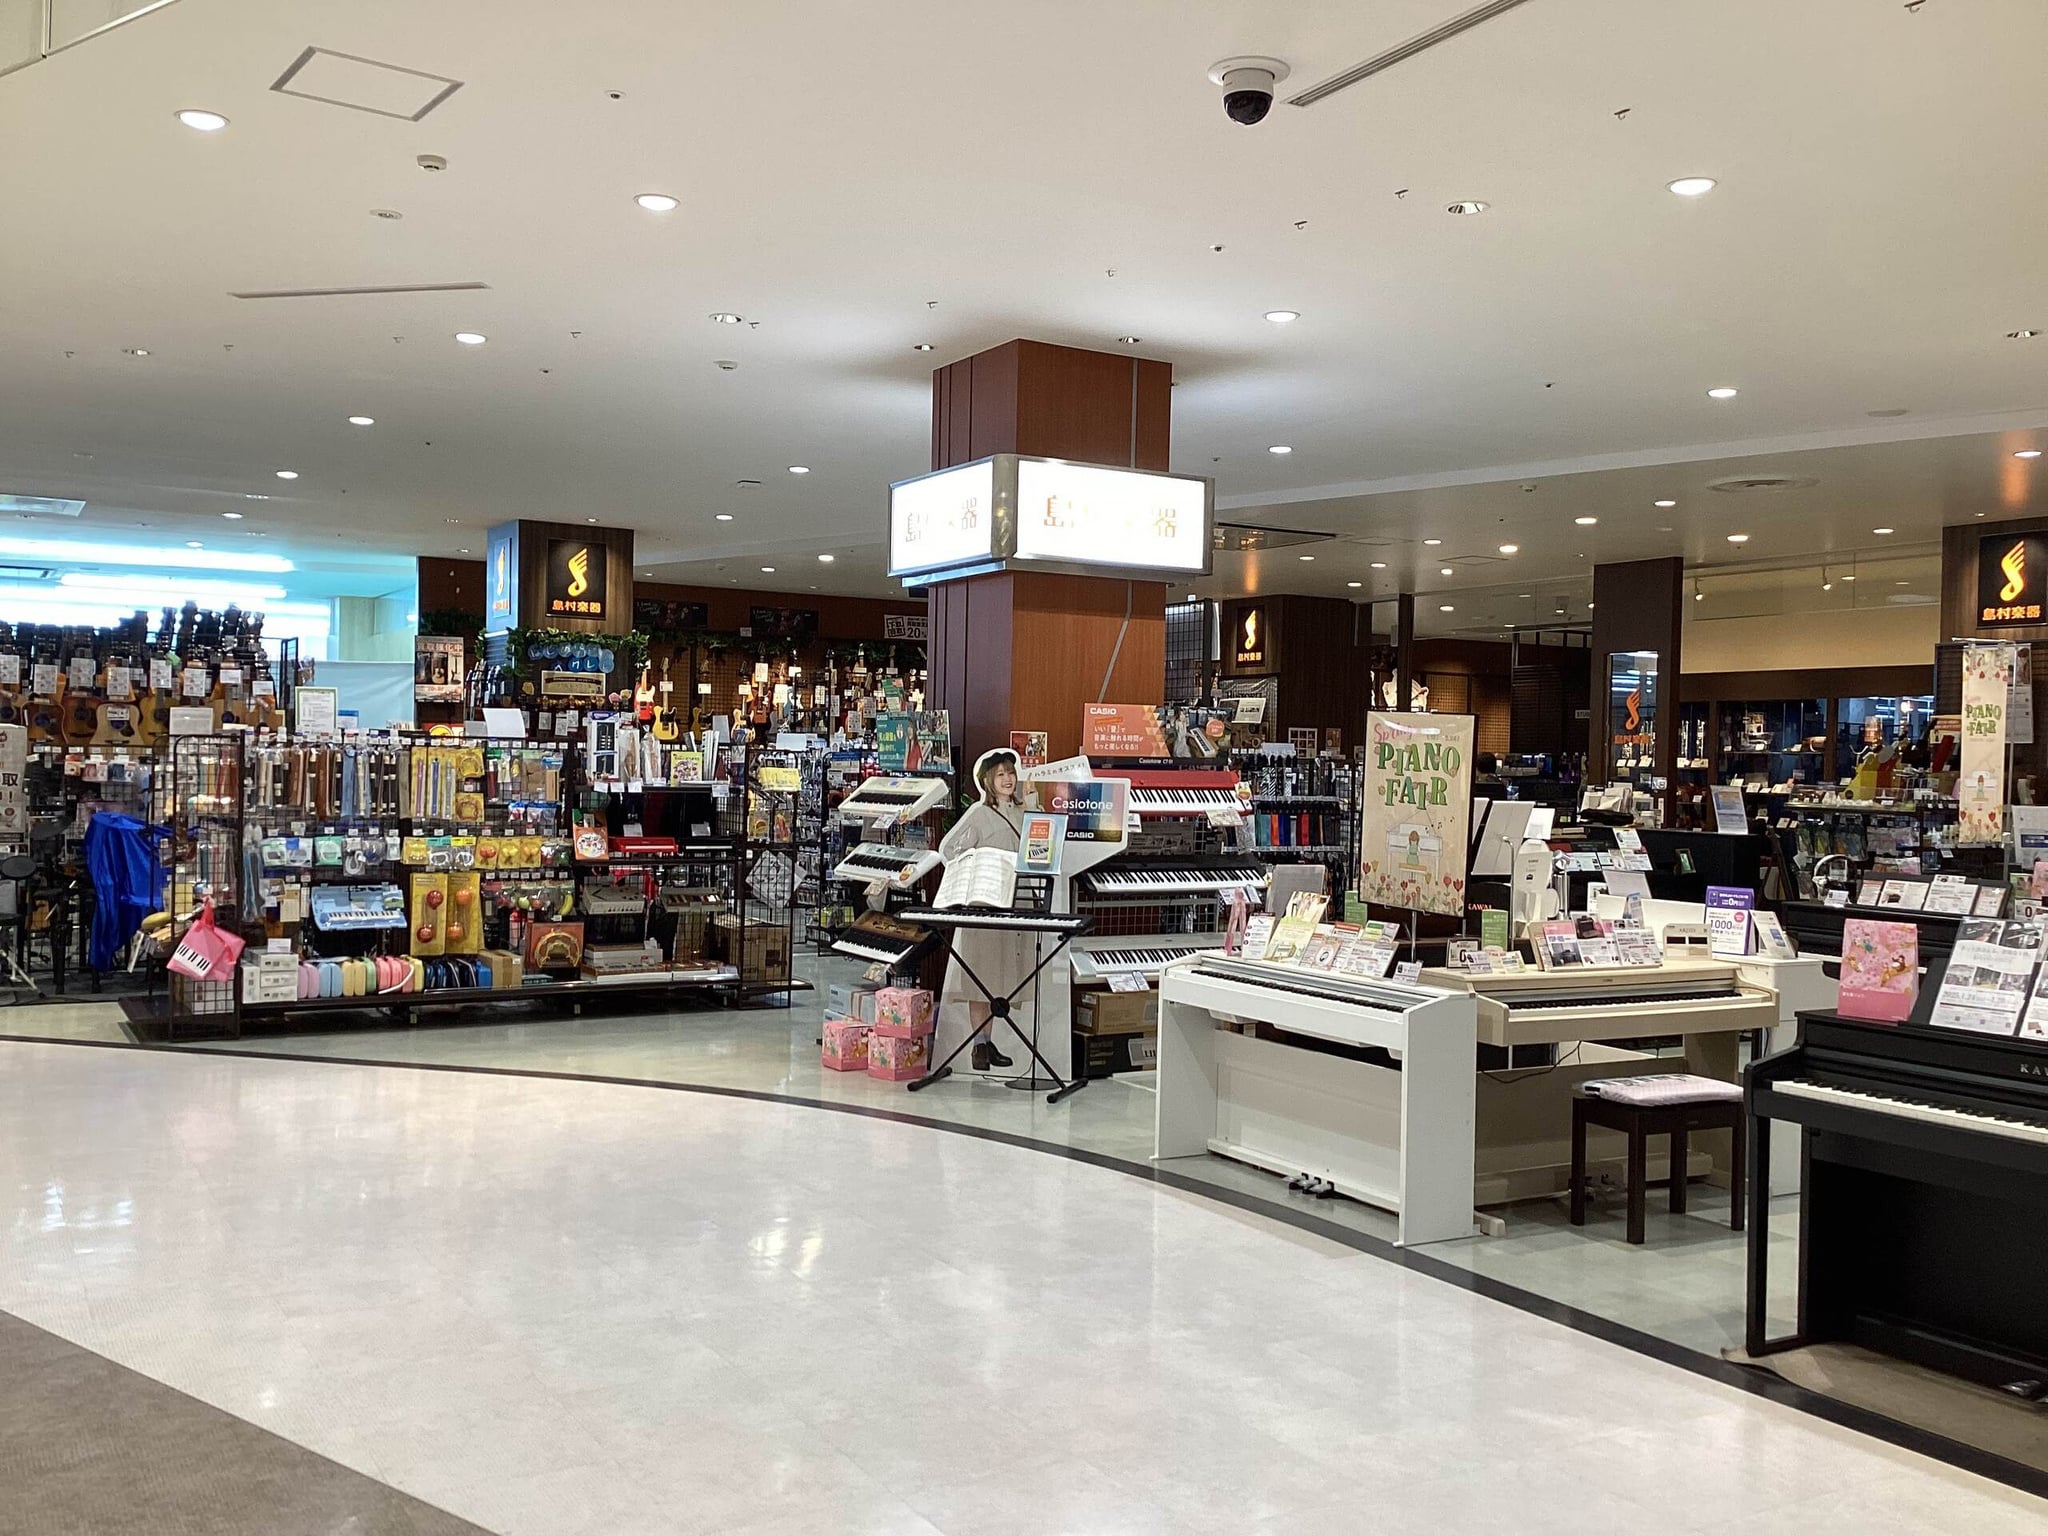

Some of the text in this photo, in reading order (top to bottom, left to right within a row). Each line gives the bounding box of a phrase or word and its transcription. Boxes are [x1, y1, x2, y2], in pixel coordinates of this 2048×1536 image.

[552, 599, 601, 613] 島村楽器
[1982, 604, 2041, 620] 島村楽器
[1089, 707, 1117, 715] CASIO
[1965, 703, 2002, 721] PIANO
[1968, 720, 1997, 737] FAIR
[1374, 742, 1461, 778] PIANO
[1385, 776, 1448, 810] FAIR
[1051, 796, 1114, 810] Casiotone
[1066, 831, 1095, 839] CASIO
